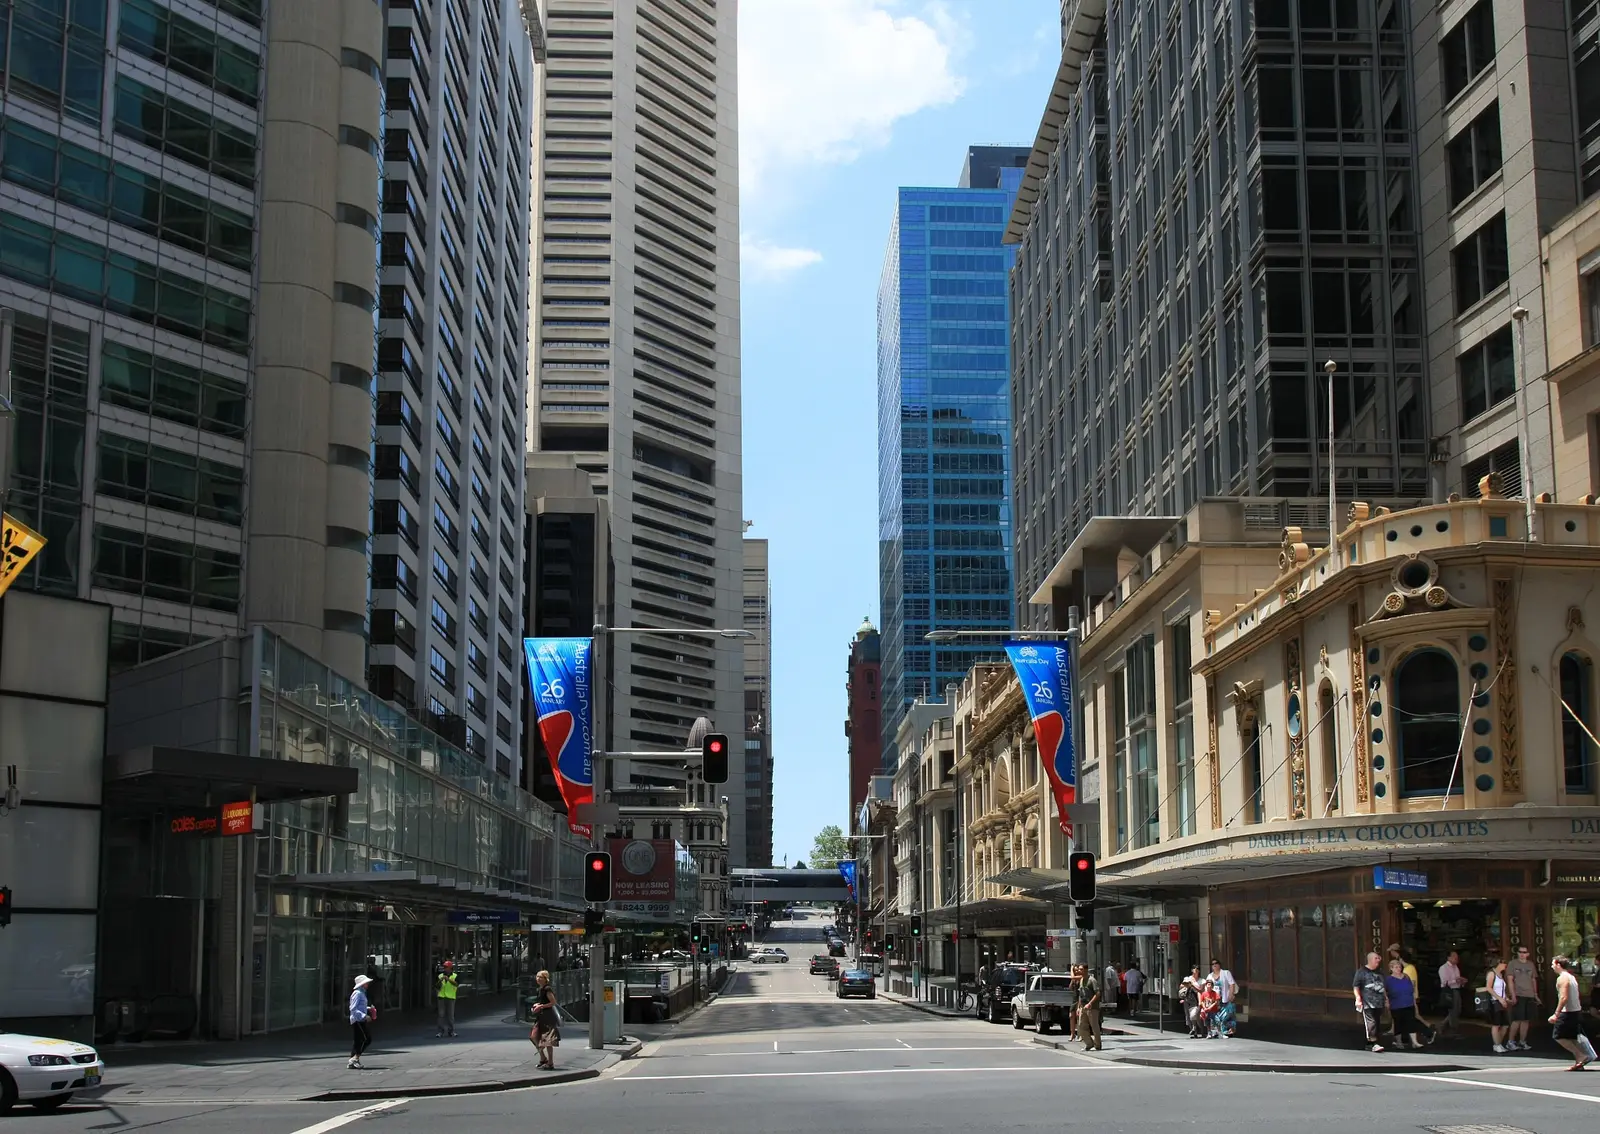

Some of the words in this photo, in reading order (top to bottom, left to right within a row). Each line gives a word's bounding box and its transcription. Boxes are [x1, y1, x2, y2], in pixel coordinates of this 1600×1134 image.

[541, 678, 565, 698] 26
[1032, 681, 1053, 699] 26
[1248, 831, 1308, 849] DARRELL
[1317, 828, 1348, 843] LEA
[1356, 820, 1489, 841] CHOCOLATES
[636, 881, 670, 889] LEASING
[648, 903, 670, 911] 9999
